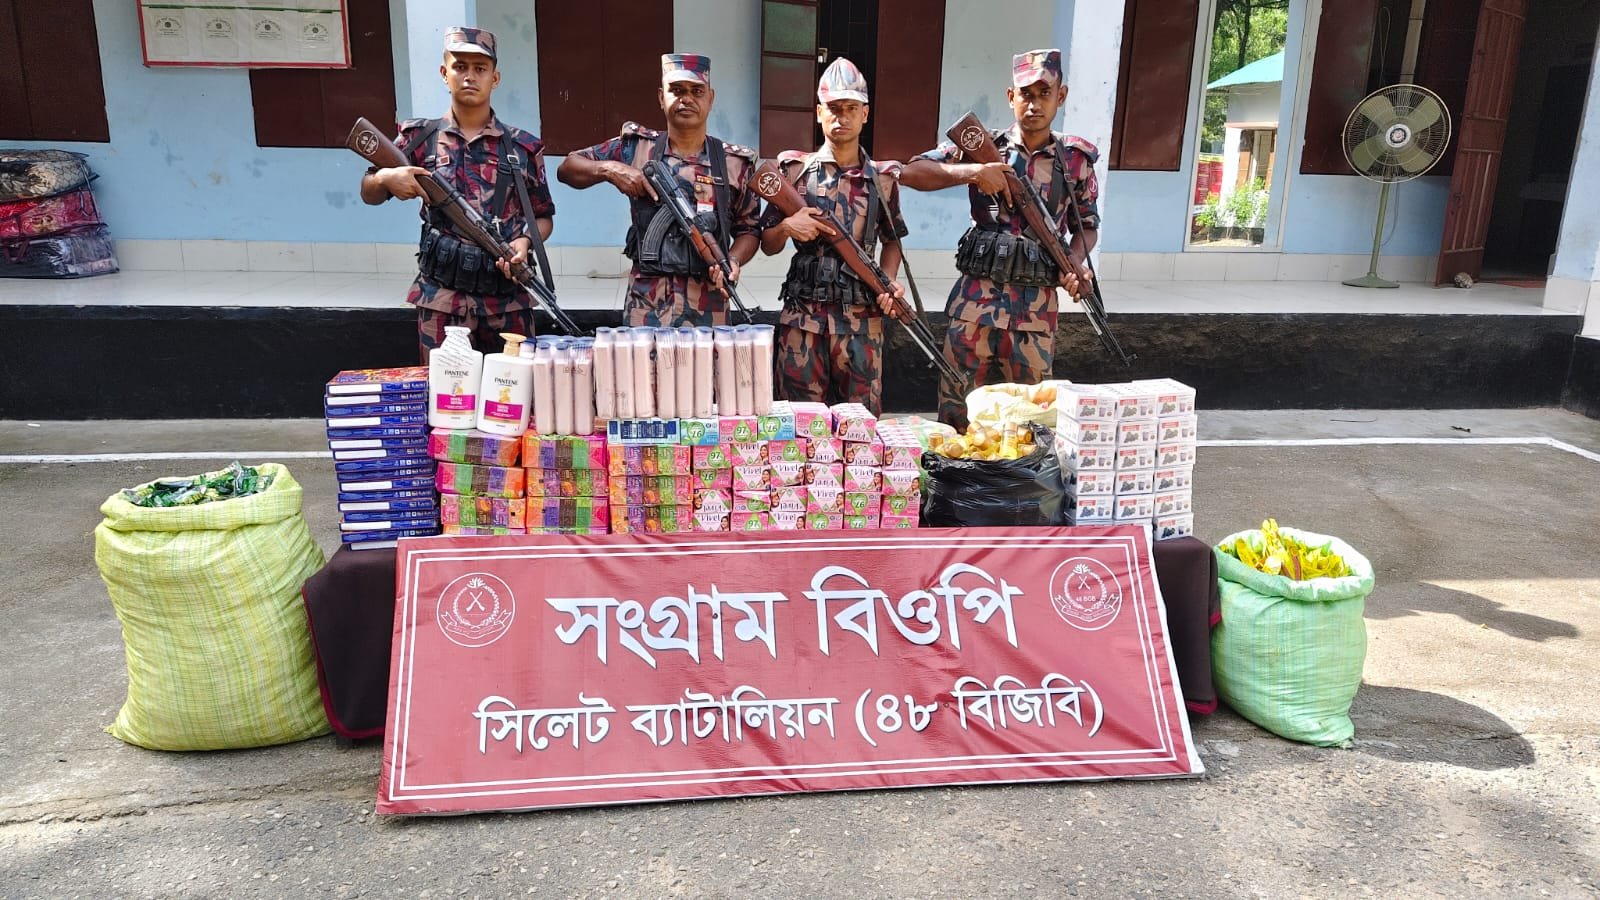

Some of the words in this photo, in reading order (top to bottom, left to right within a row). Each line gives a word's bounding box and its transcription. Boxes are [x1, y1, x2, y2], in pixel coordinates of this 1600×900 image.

[494, 377, 519, 386] PANTENE
[545, 584, 788, 664] সংগ্রাম
[802, 562, 1024, 656] বিওপি
[472, 692, 616, 753] সিলেট
[625, 685, 840, 746] ব্যাটালিয়ন
[854, 688, 937, 746] (৪৮
[950, 672, 1103, 737] বিজিবি)
